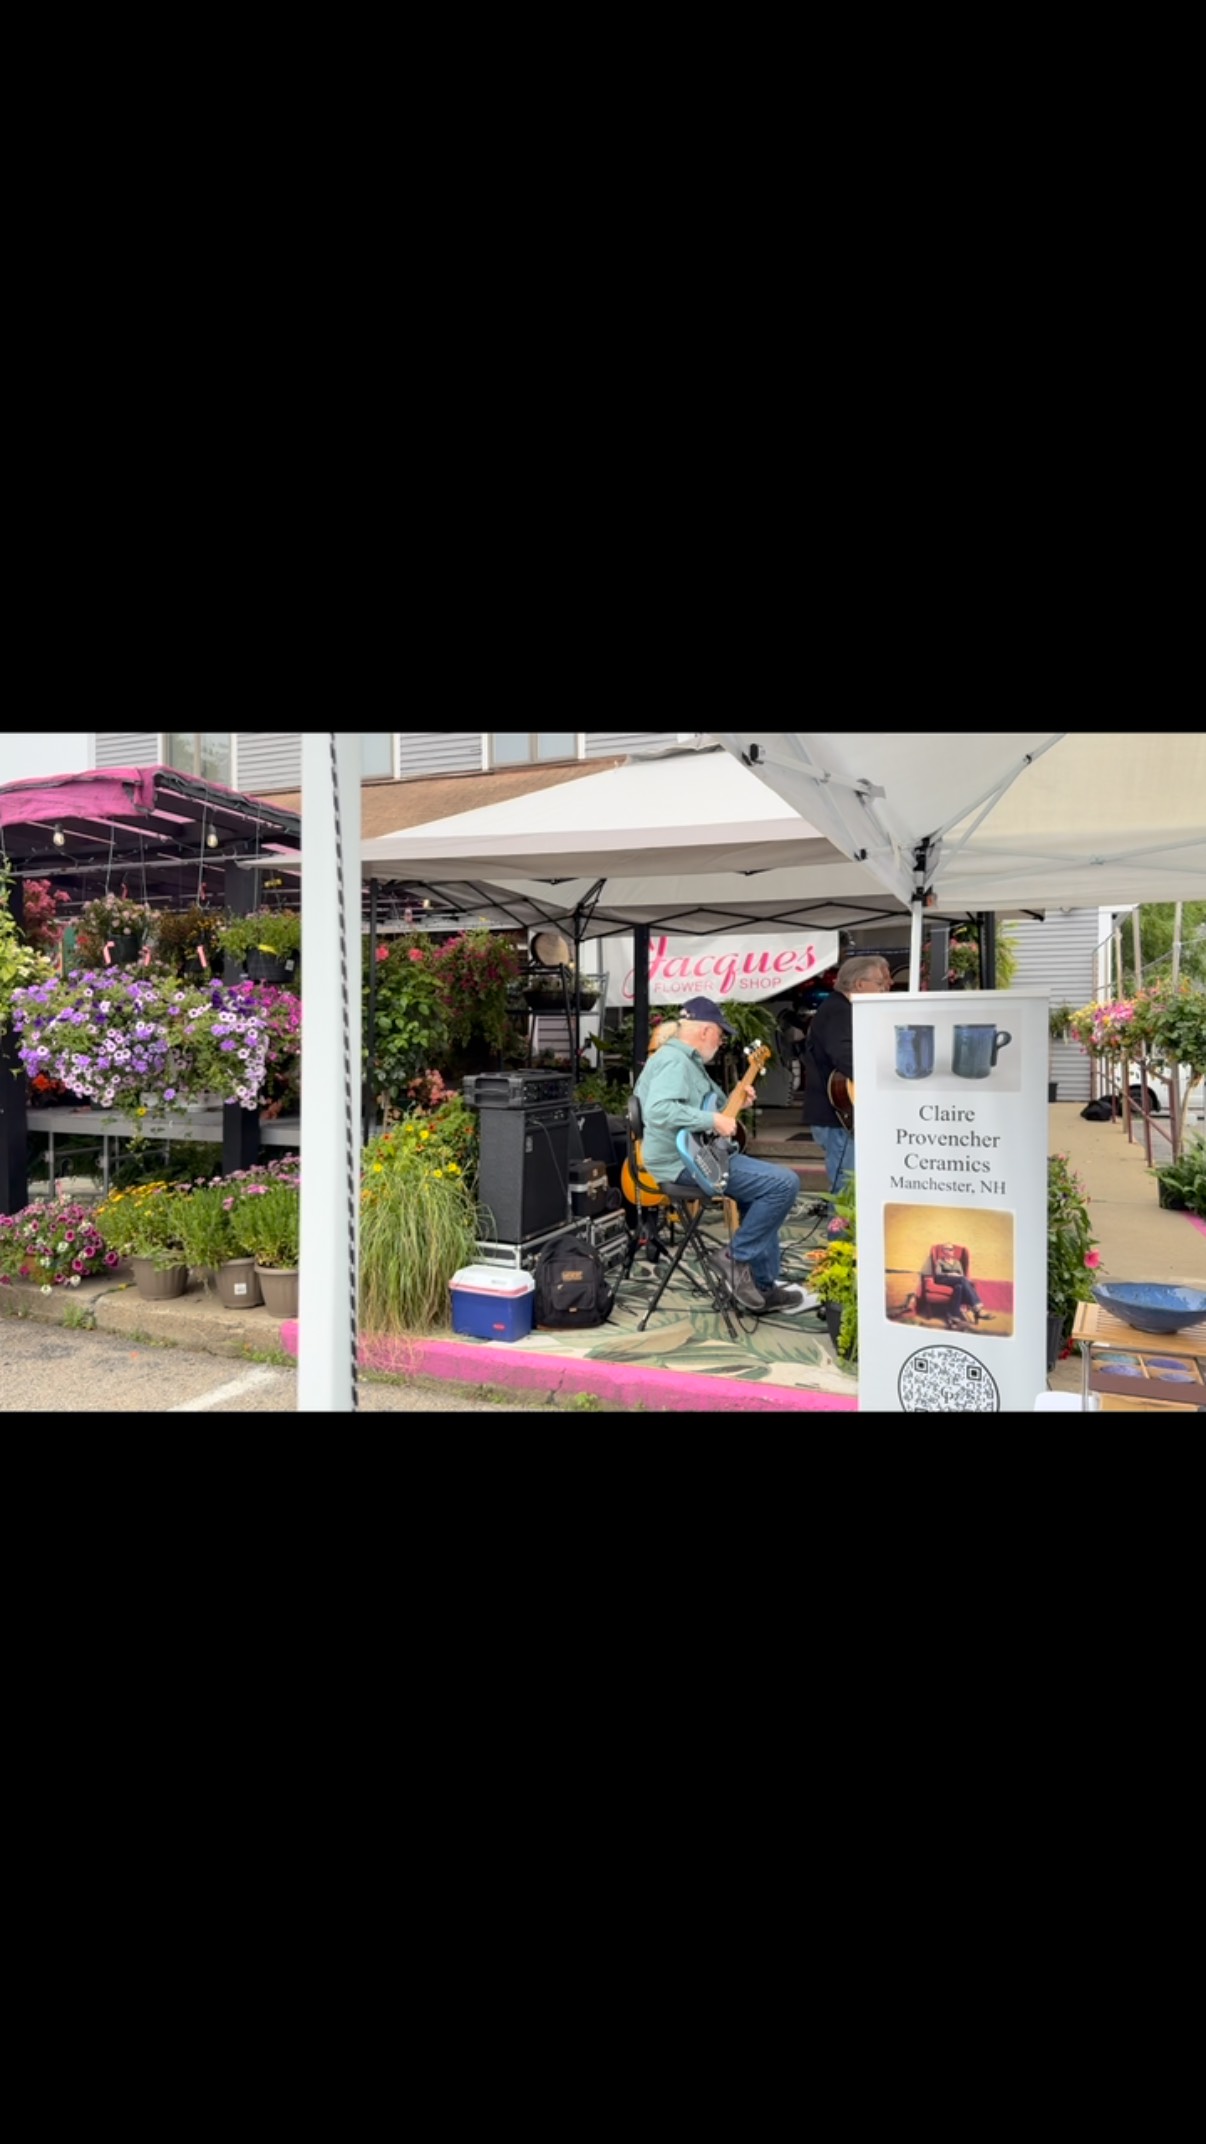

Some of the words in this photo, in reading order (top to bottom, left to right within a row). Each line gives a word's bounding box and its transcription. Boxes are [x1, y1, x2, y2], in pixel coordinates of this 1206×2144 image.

[622, 936, 817, 998] Jacques
[654, 982, 714, 993] FLOWER
[740, 977, 782, 989] SHOP
[919, 1105, 976, 1122] Claire
[896, 1129, 1001, 1148] Provencher
[904, 1153, 991, 1173] Ceramics
[890, 1176, 975, 1193] Manchester,
[980, 1180, 1006, 1195] NH
